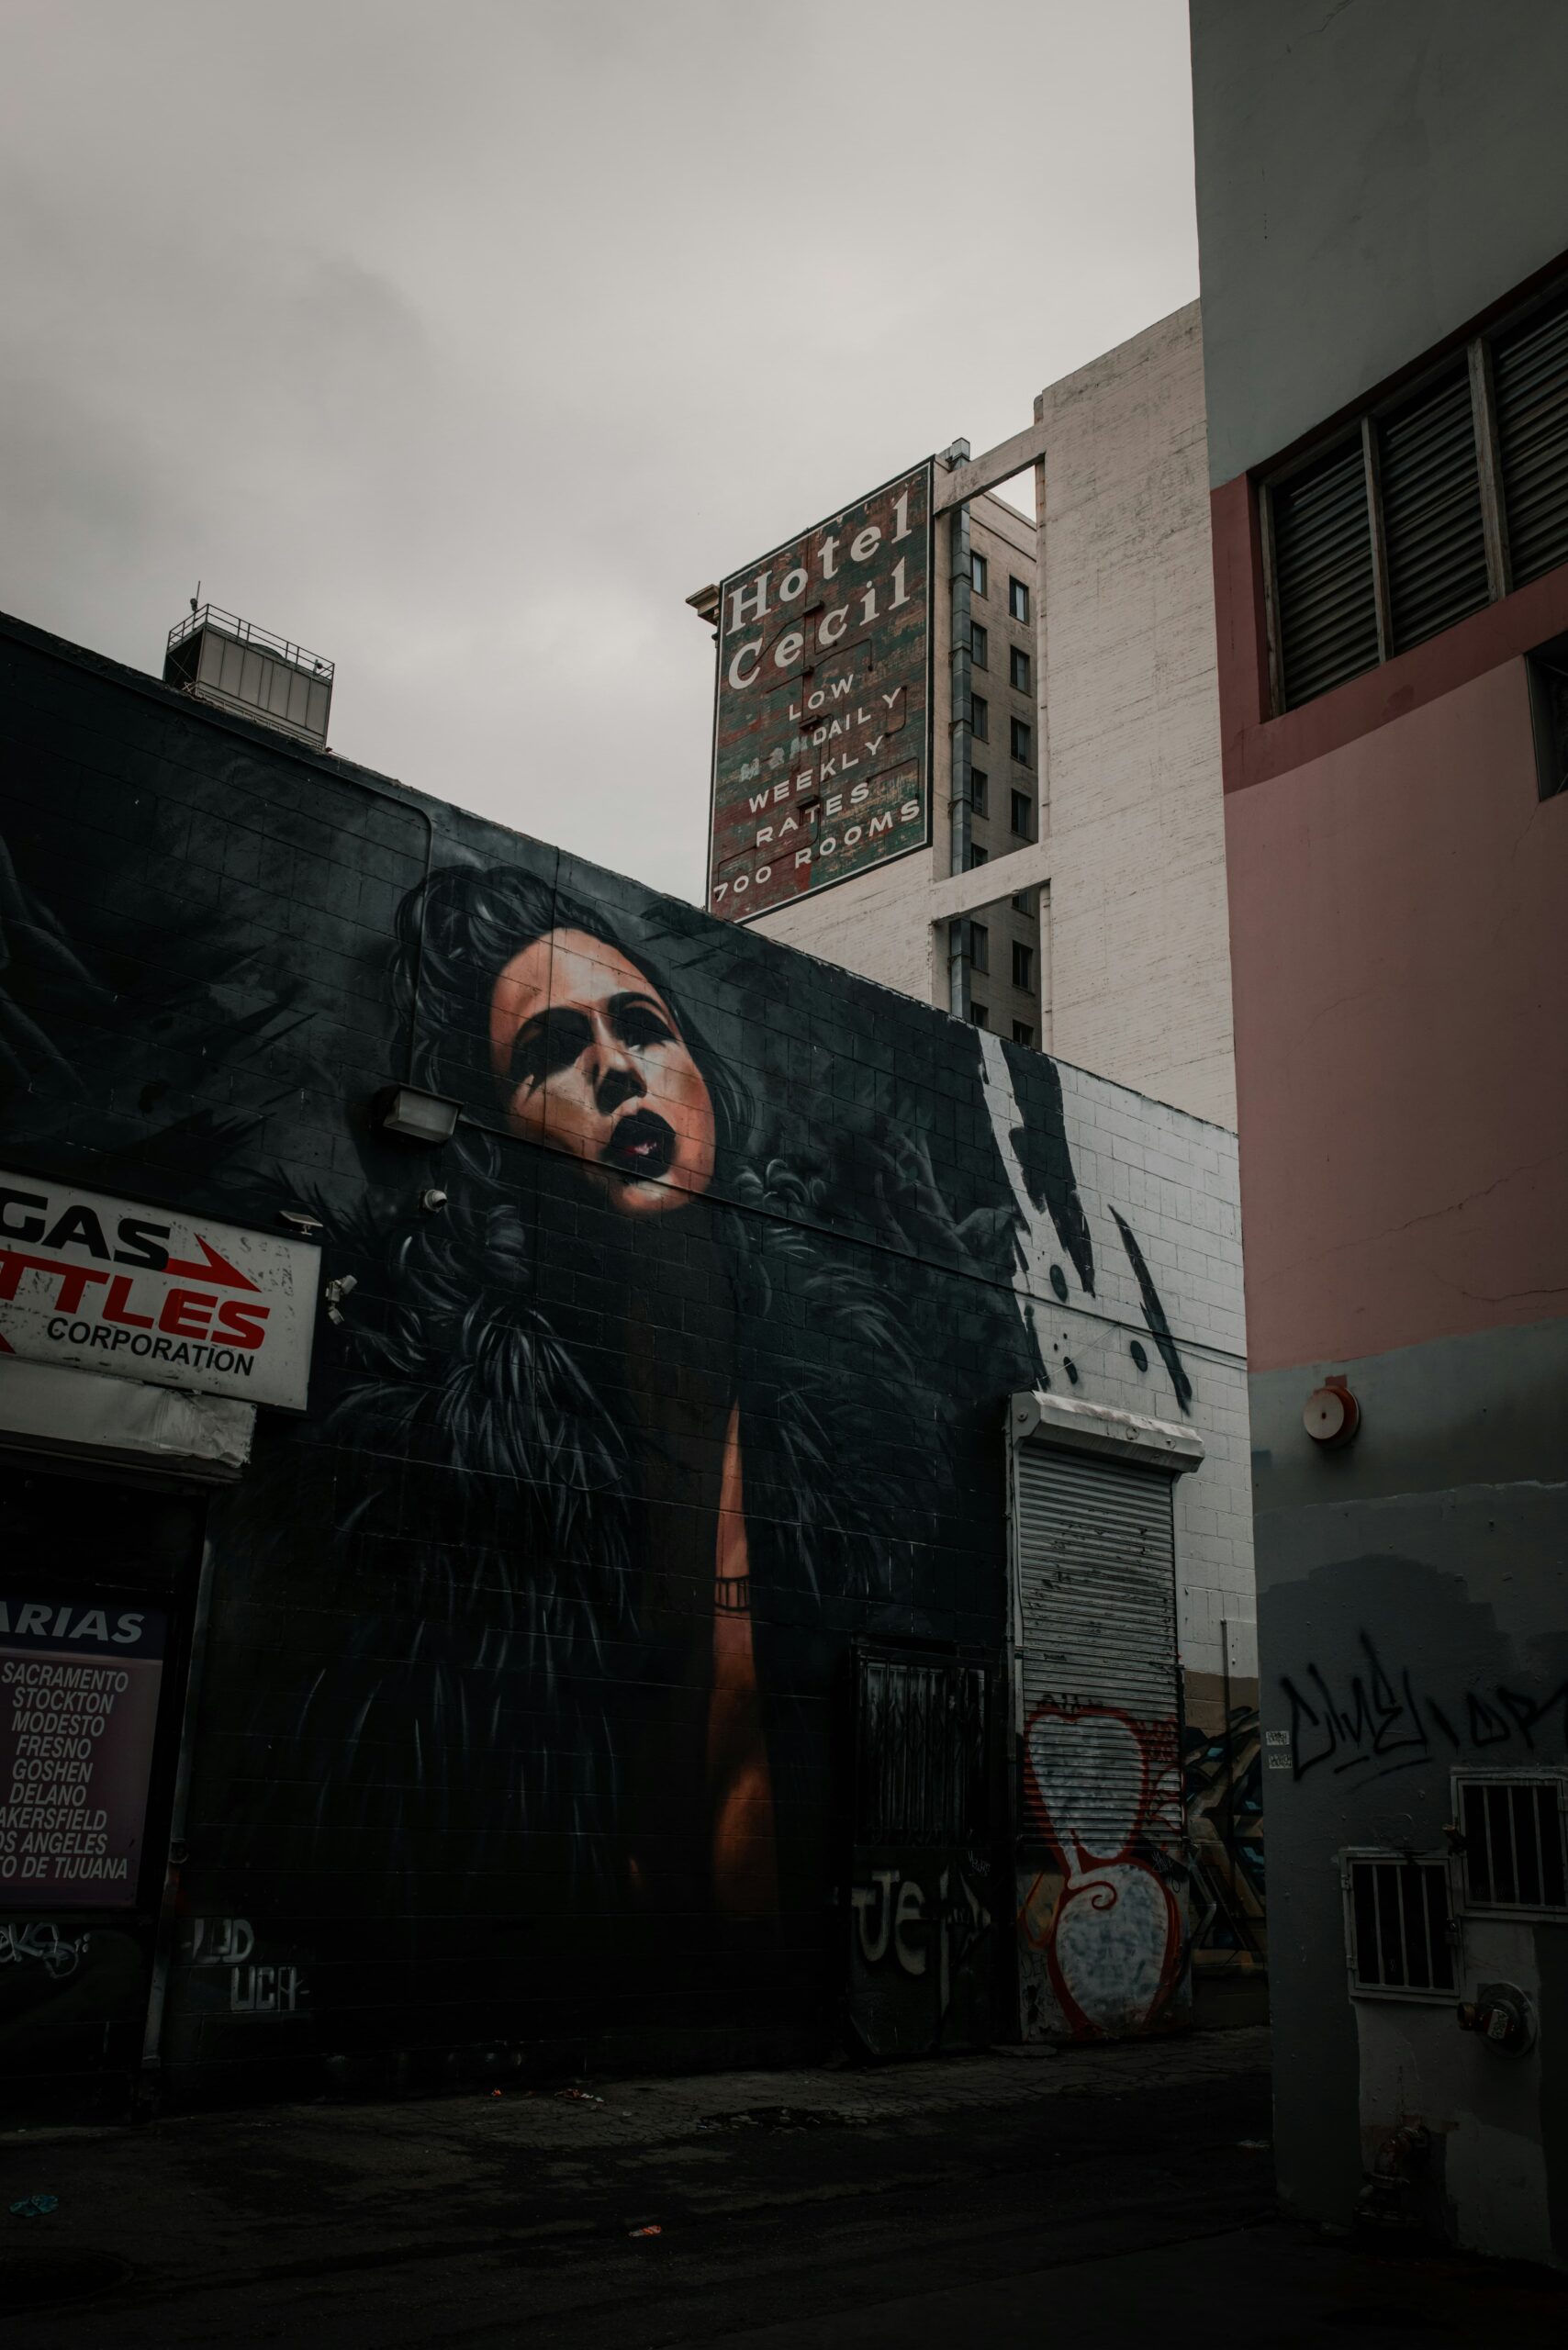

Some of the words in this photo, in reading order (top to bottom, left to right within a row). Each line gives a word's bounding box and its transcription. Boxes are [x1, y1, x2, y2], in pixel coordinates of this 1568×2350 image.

[726, 489, 913, 636] Hotel
[728, 555, 911, 689] Cecil
[789, 674, 854, 721] LOW
[812, 687, 902, 746] DAILY
[748, 735, 883, 813] WEEKLY
[756, 782, 869, 847] RATES
[713, 866, 772, 902] 700
[795, 799, 920, 868] ROOMS
[0, 1187, 171, 1270] GAS
[47, 1316, 254, 1376] CORPORATION
[0, 1600, 146, 1643] RIAS
[1, 1662, 129, 1693] SACRAMENTO
[12, 1686, 115, 1715] STOCKTON
[11, 1710, 105, 1737] MODESTO
[16, 1734, 92, 1760] FRESNO
[12, 1758, 94, 1783] GOSHEN
[8, 1782, 87, 1807] DELANO
[19, 1830, 108, 1855] ANGELES
[21, 1855, 50, 1878] DE
[55, 1856, 128, 1880] TIJUANA
